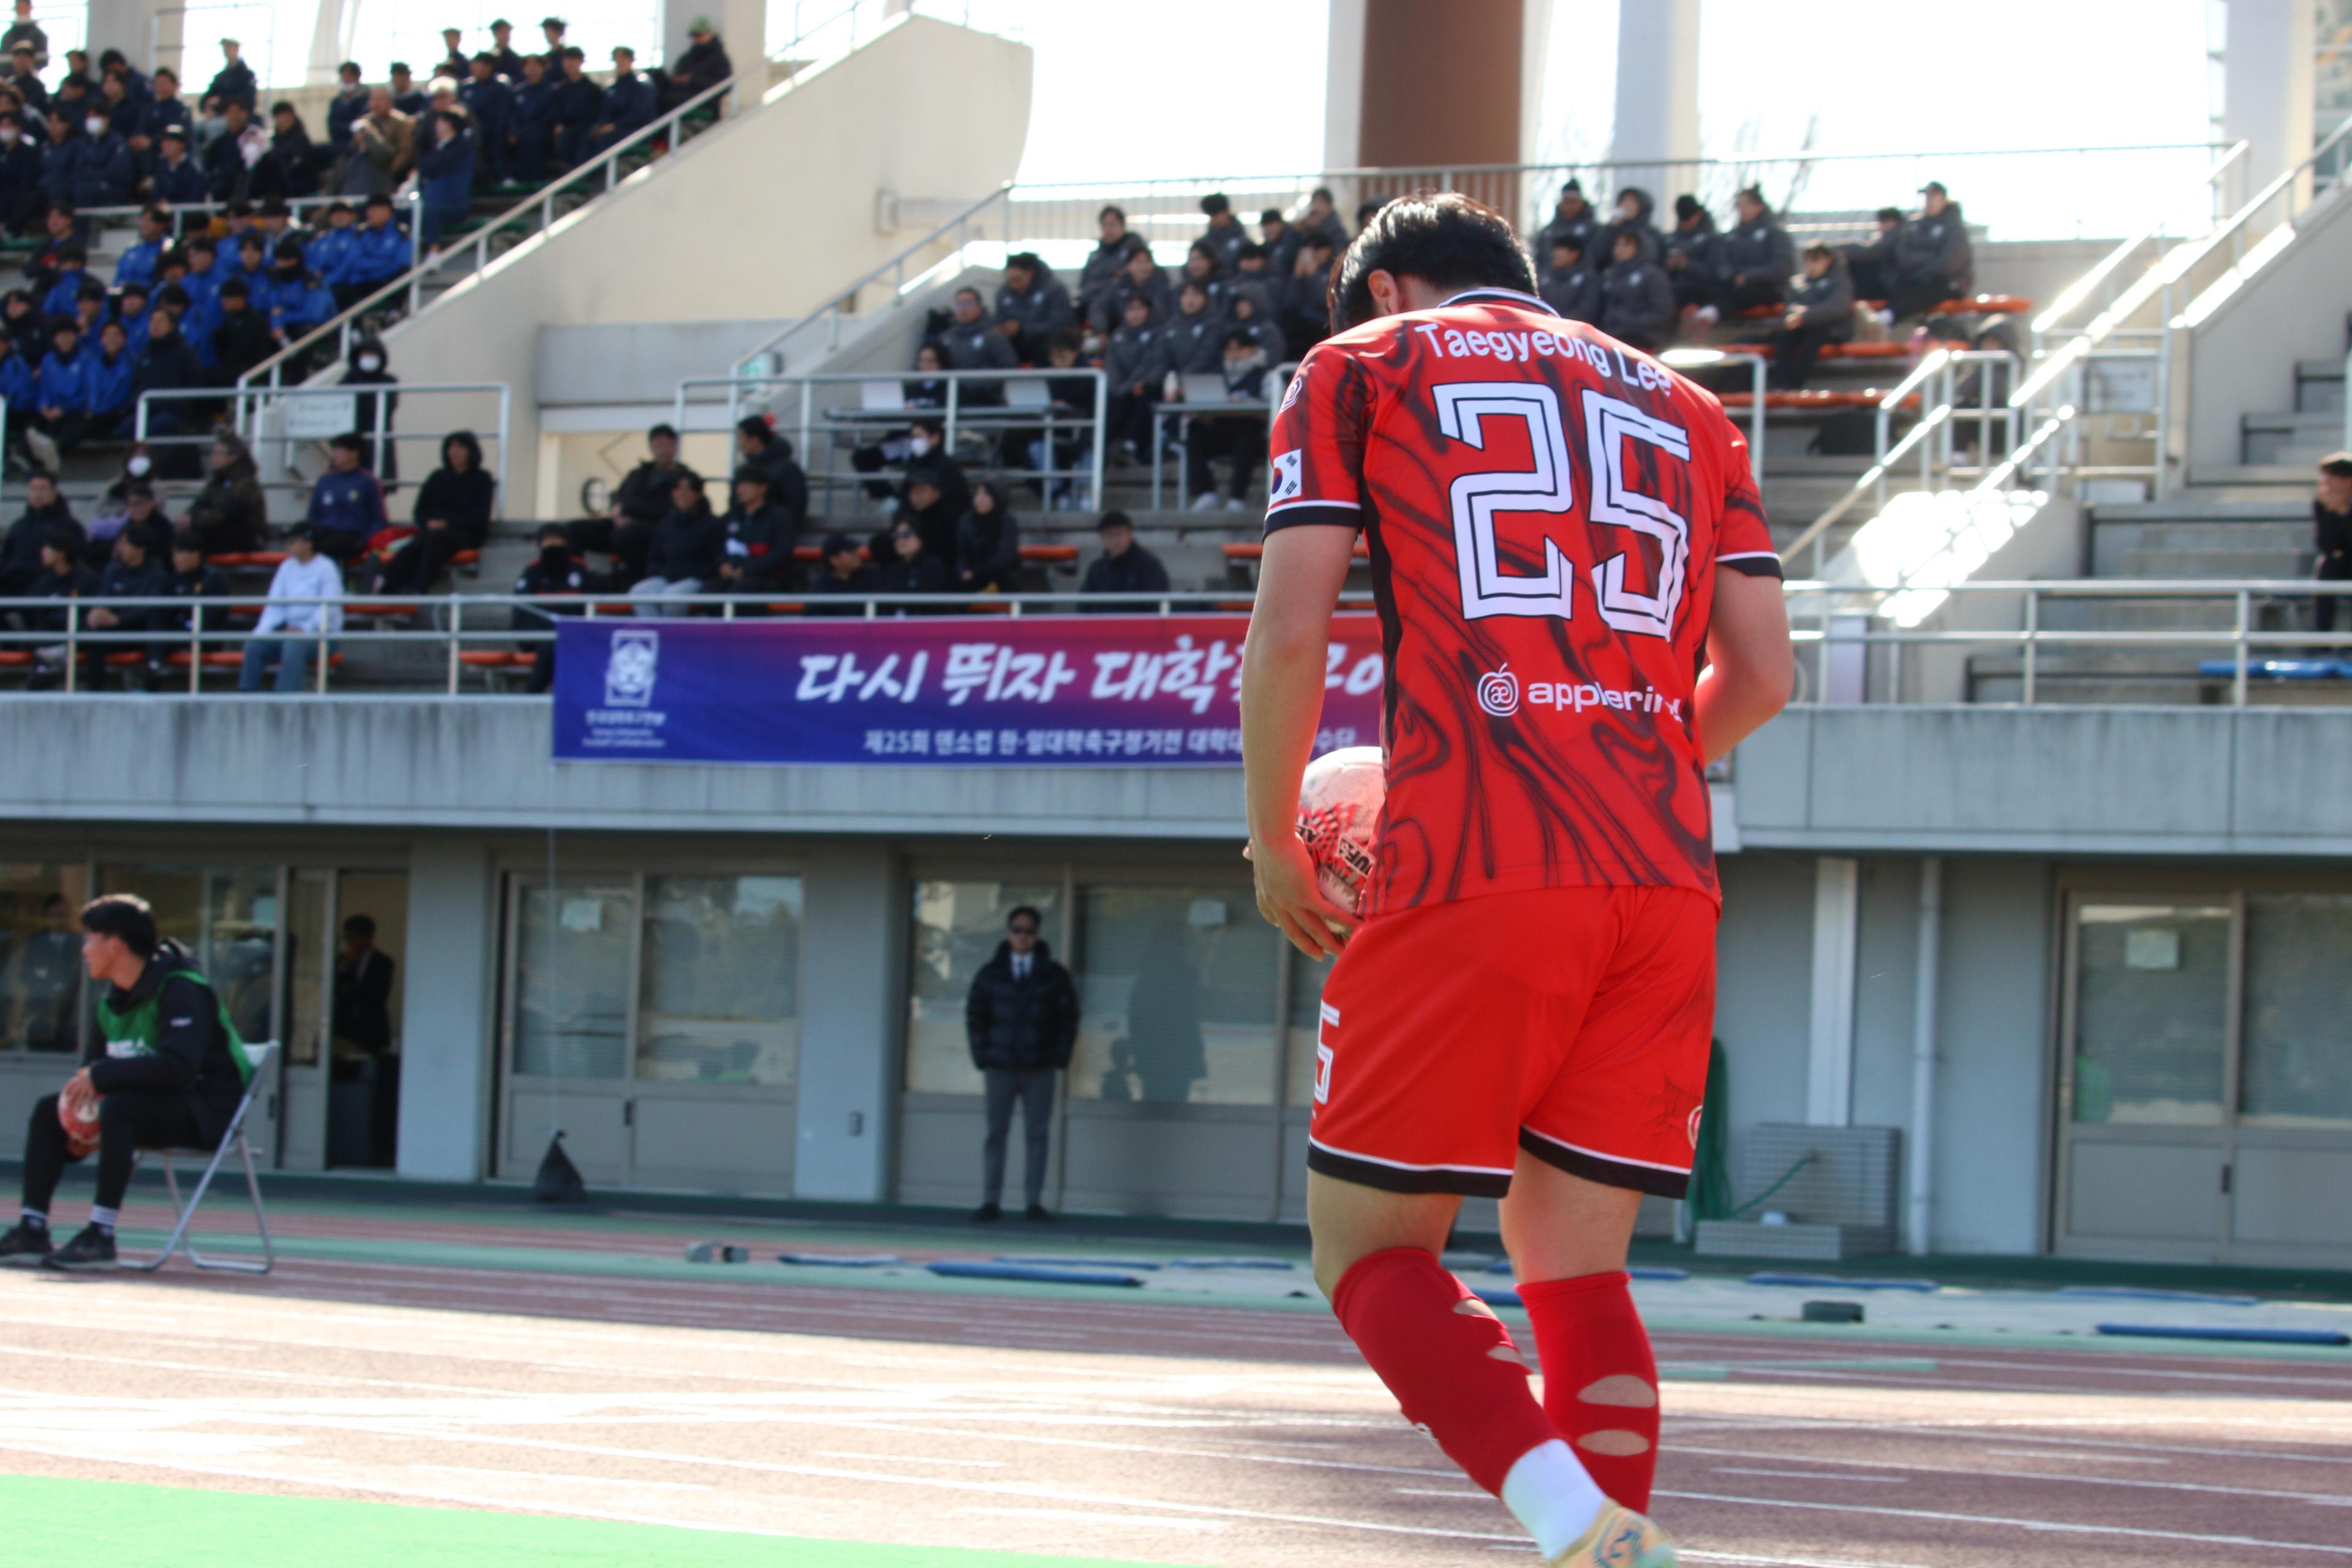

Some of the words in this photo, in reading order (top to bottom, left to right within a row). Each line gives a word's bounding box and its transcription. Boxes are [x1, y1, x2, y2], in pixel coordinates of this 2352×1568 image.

[1414, 323, 1612, 378] Taegyeong
[1613, 347, 1672, 396] Lee
[1432, 382, 1690, 642] 25
[796, 650, 929, 704] 다시
[942, 643, 1076, 706] 뛰자
[864, 729, 930, 755] 제25회
